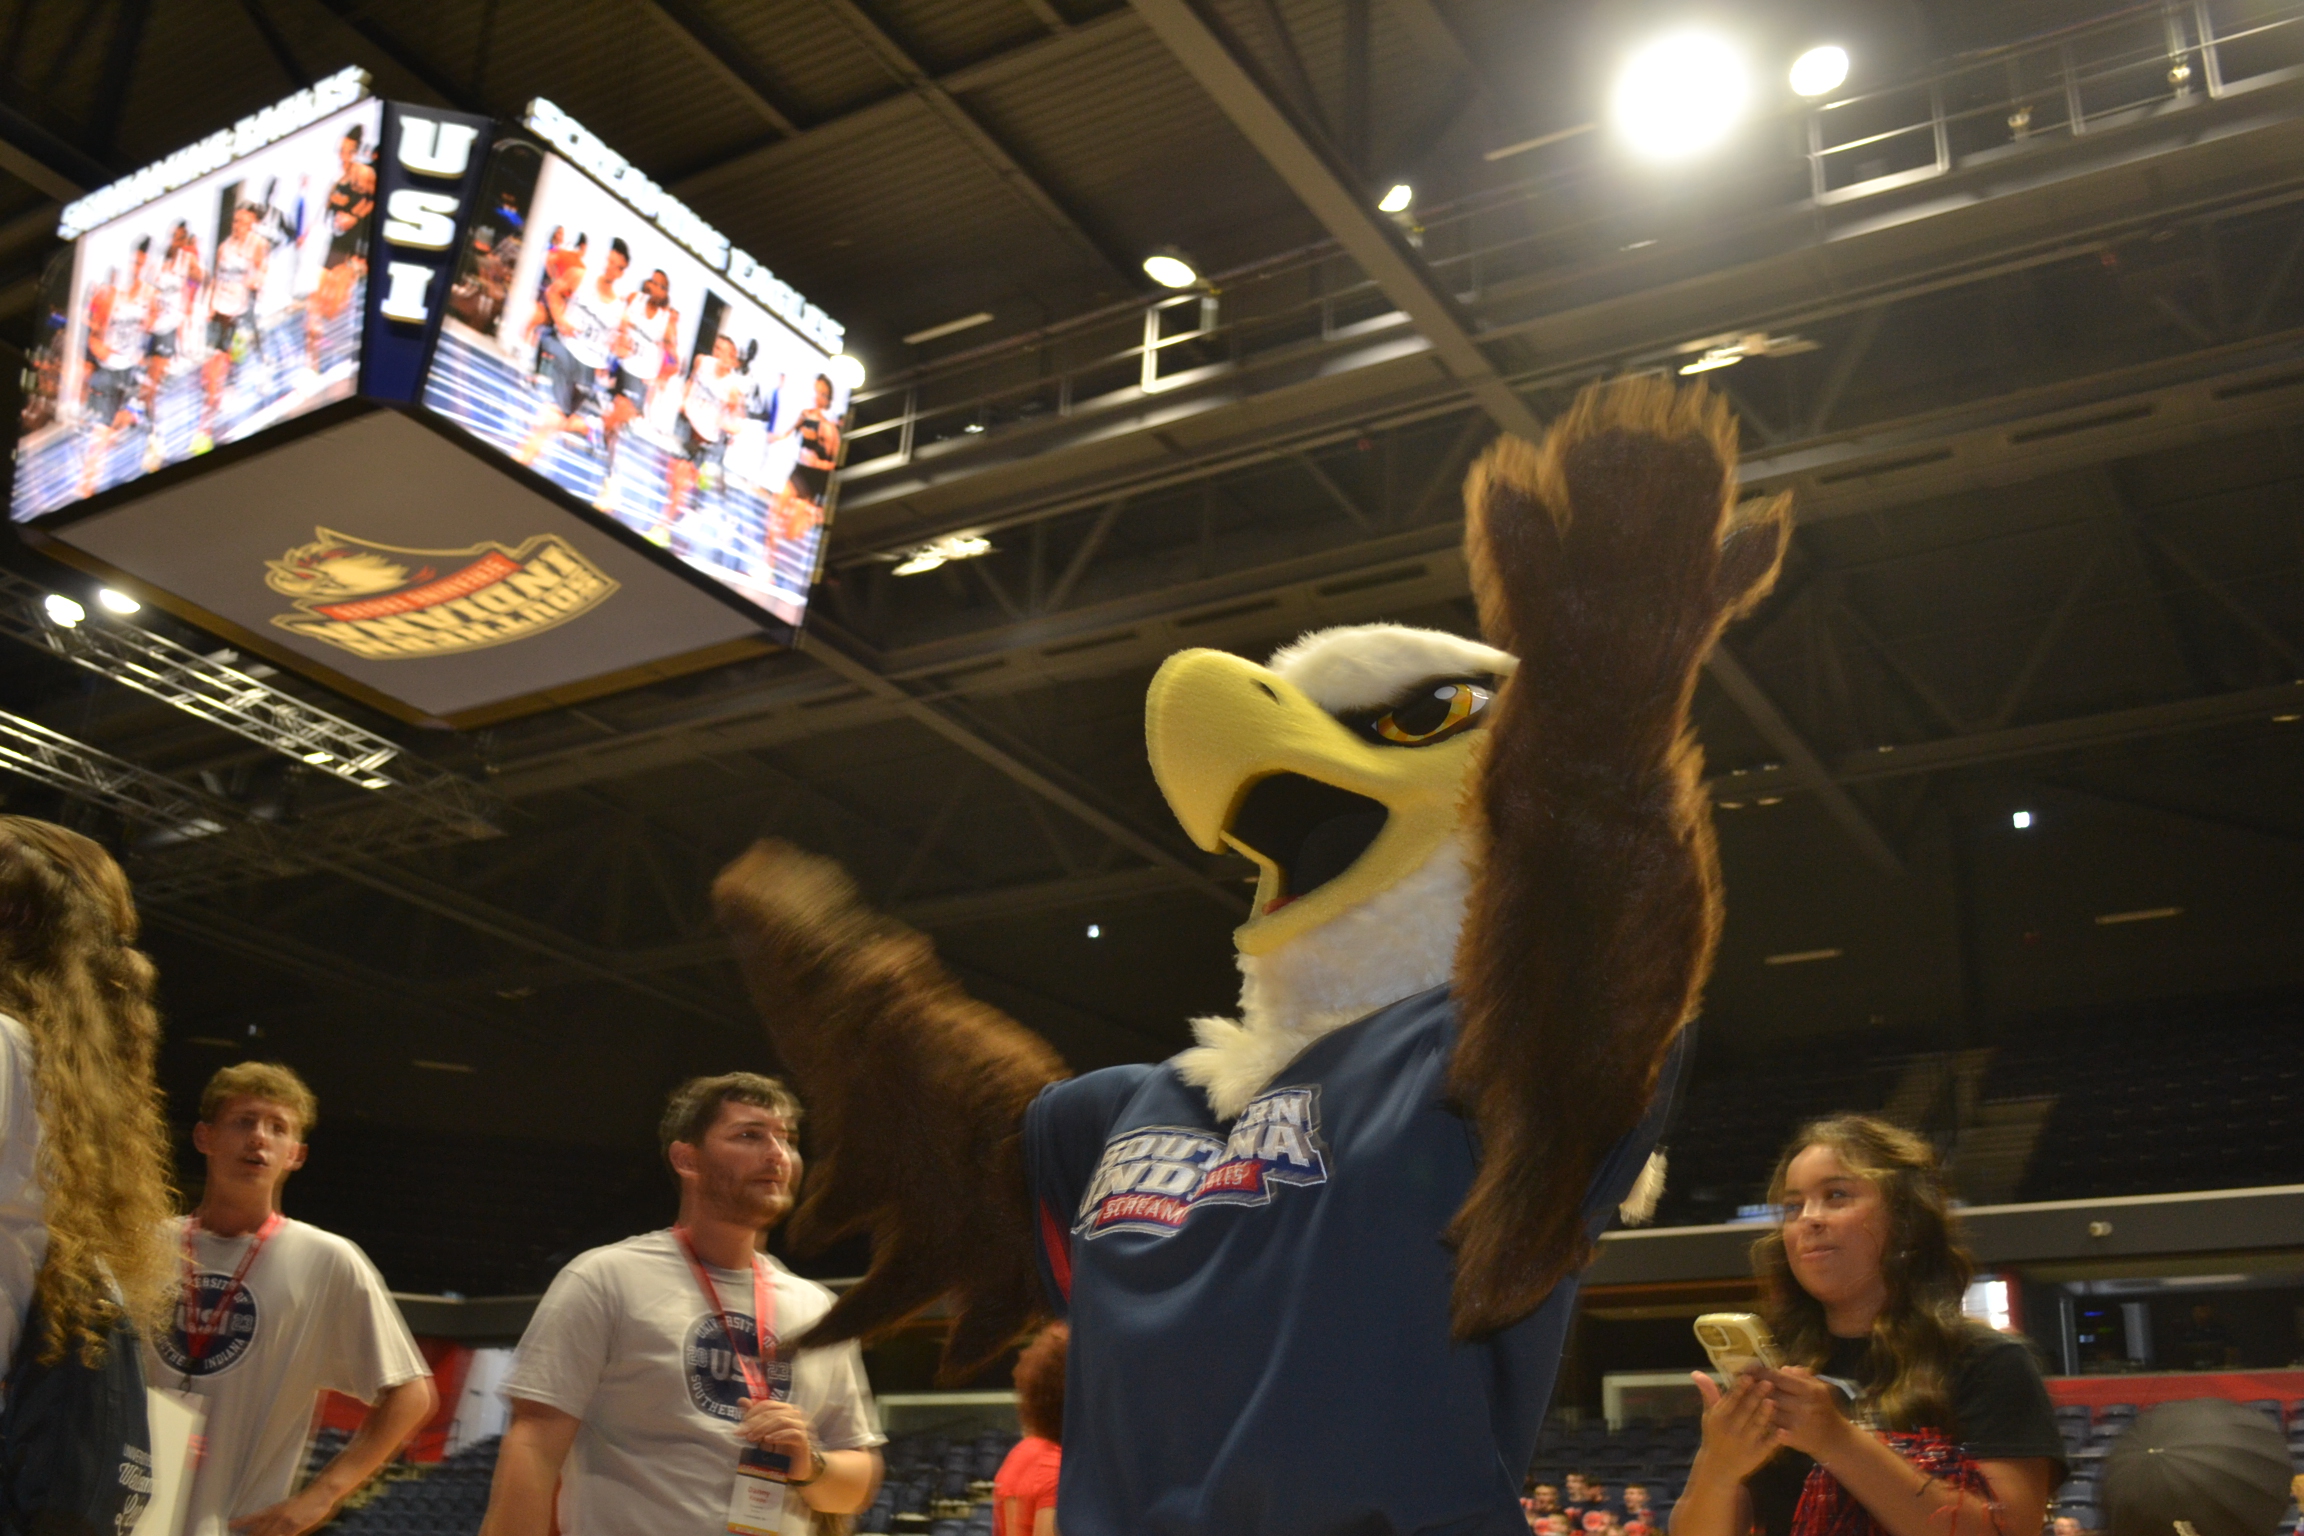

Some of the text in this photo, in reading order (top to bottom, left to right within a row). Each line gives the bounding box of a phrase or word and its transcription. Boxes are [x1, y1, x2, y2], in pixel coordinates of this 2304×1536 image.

[380, 115, 479, 324] USI
[297, 545, 581, 640] INDIANA
[1103, 1199, 1183, 1224] SCREAM
[694, 1315, 757, 1340] UNIVRSIT
[204, 1338, 246, 1370] INDIANA
